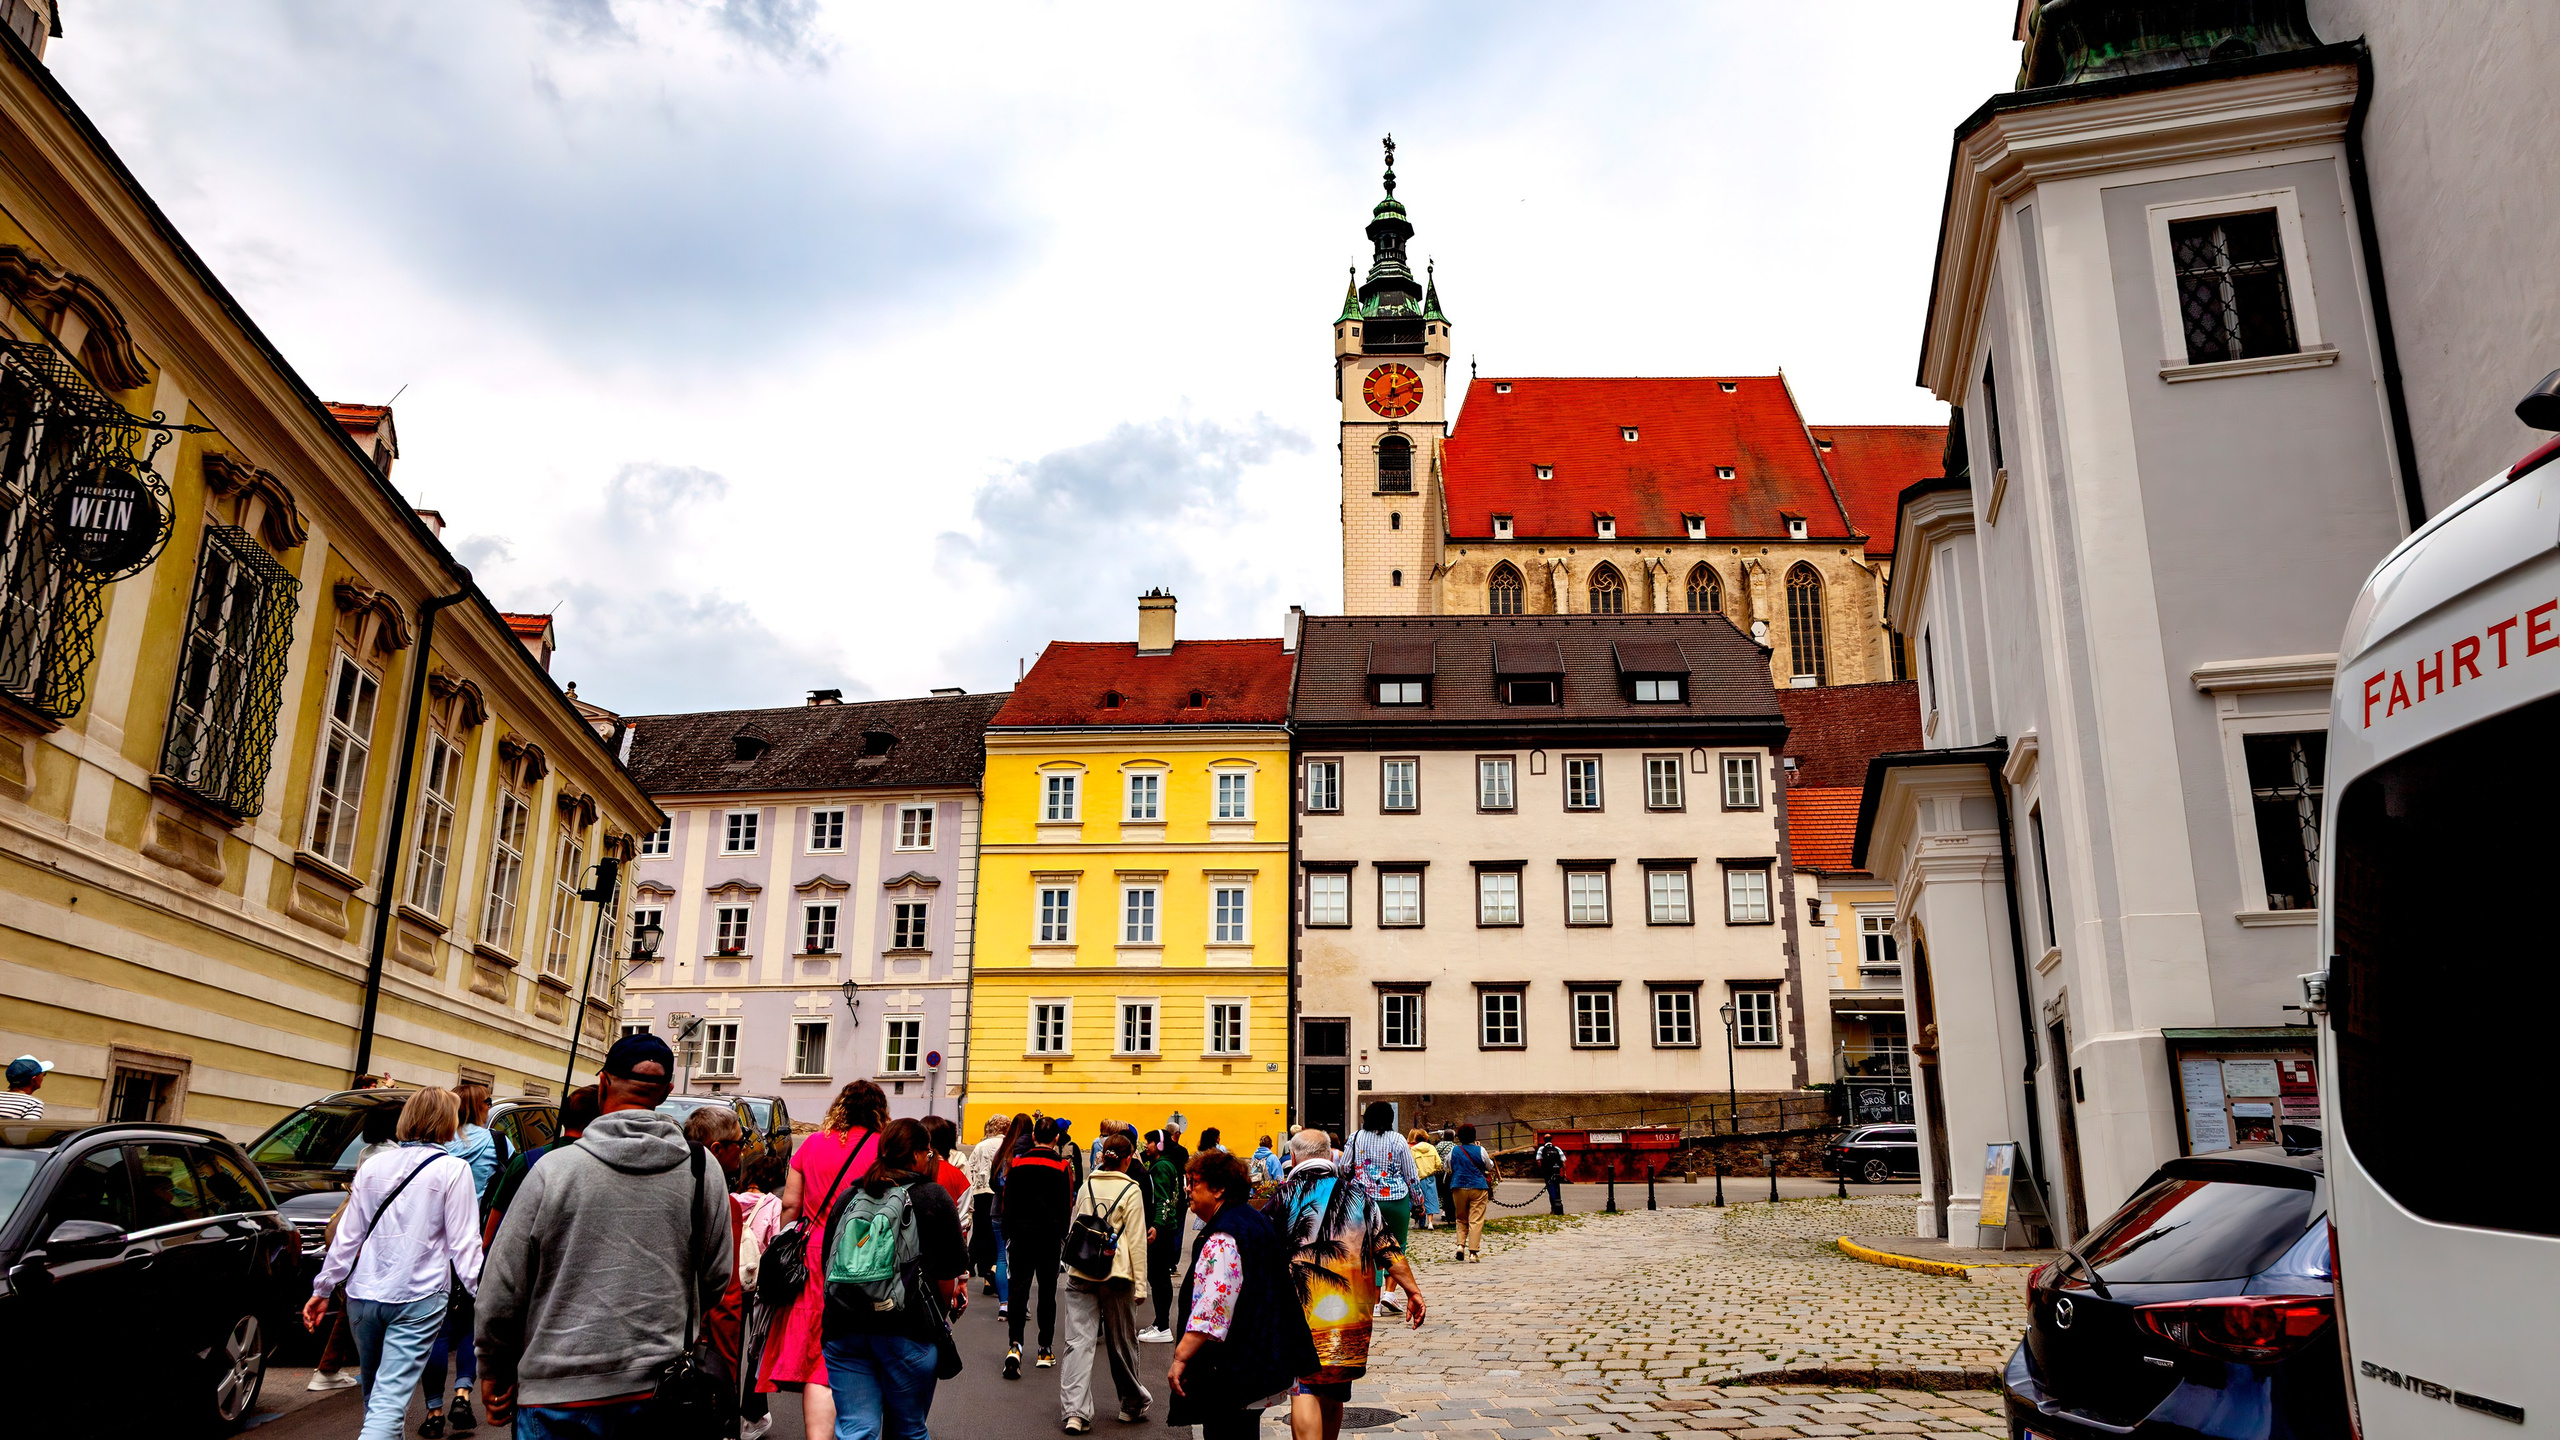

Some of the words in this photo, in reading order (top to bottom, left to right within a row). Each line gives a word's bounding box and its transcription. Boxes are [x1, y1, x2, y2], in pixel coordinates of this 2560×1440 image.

[75, 486, 135, 499] PROPSTEI
[69, 496, 133, 531] WEIN
[83, 532, 110, 543] GUT
[2363, 597, 2560, 730] FAHRTE
[1655, 1133, 1676, 1141] 1037
[2360, 1360, 2452, 1404] SPRINTER
